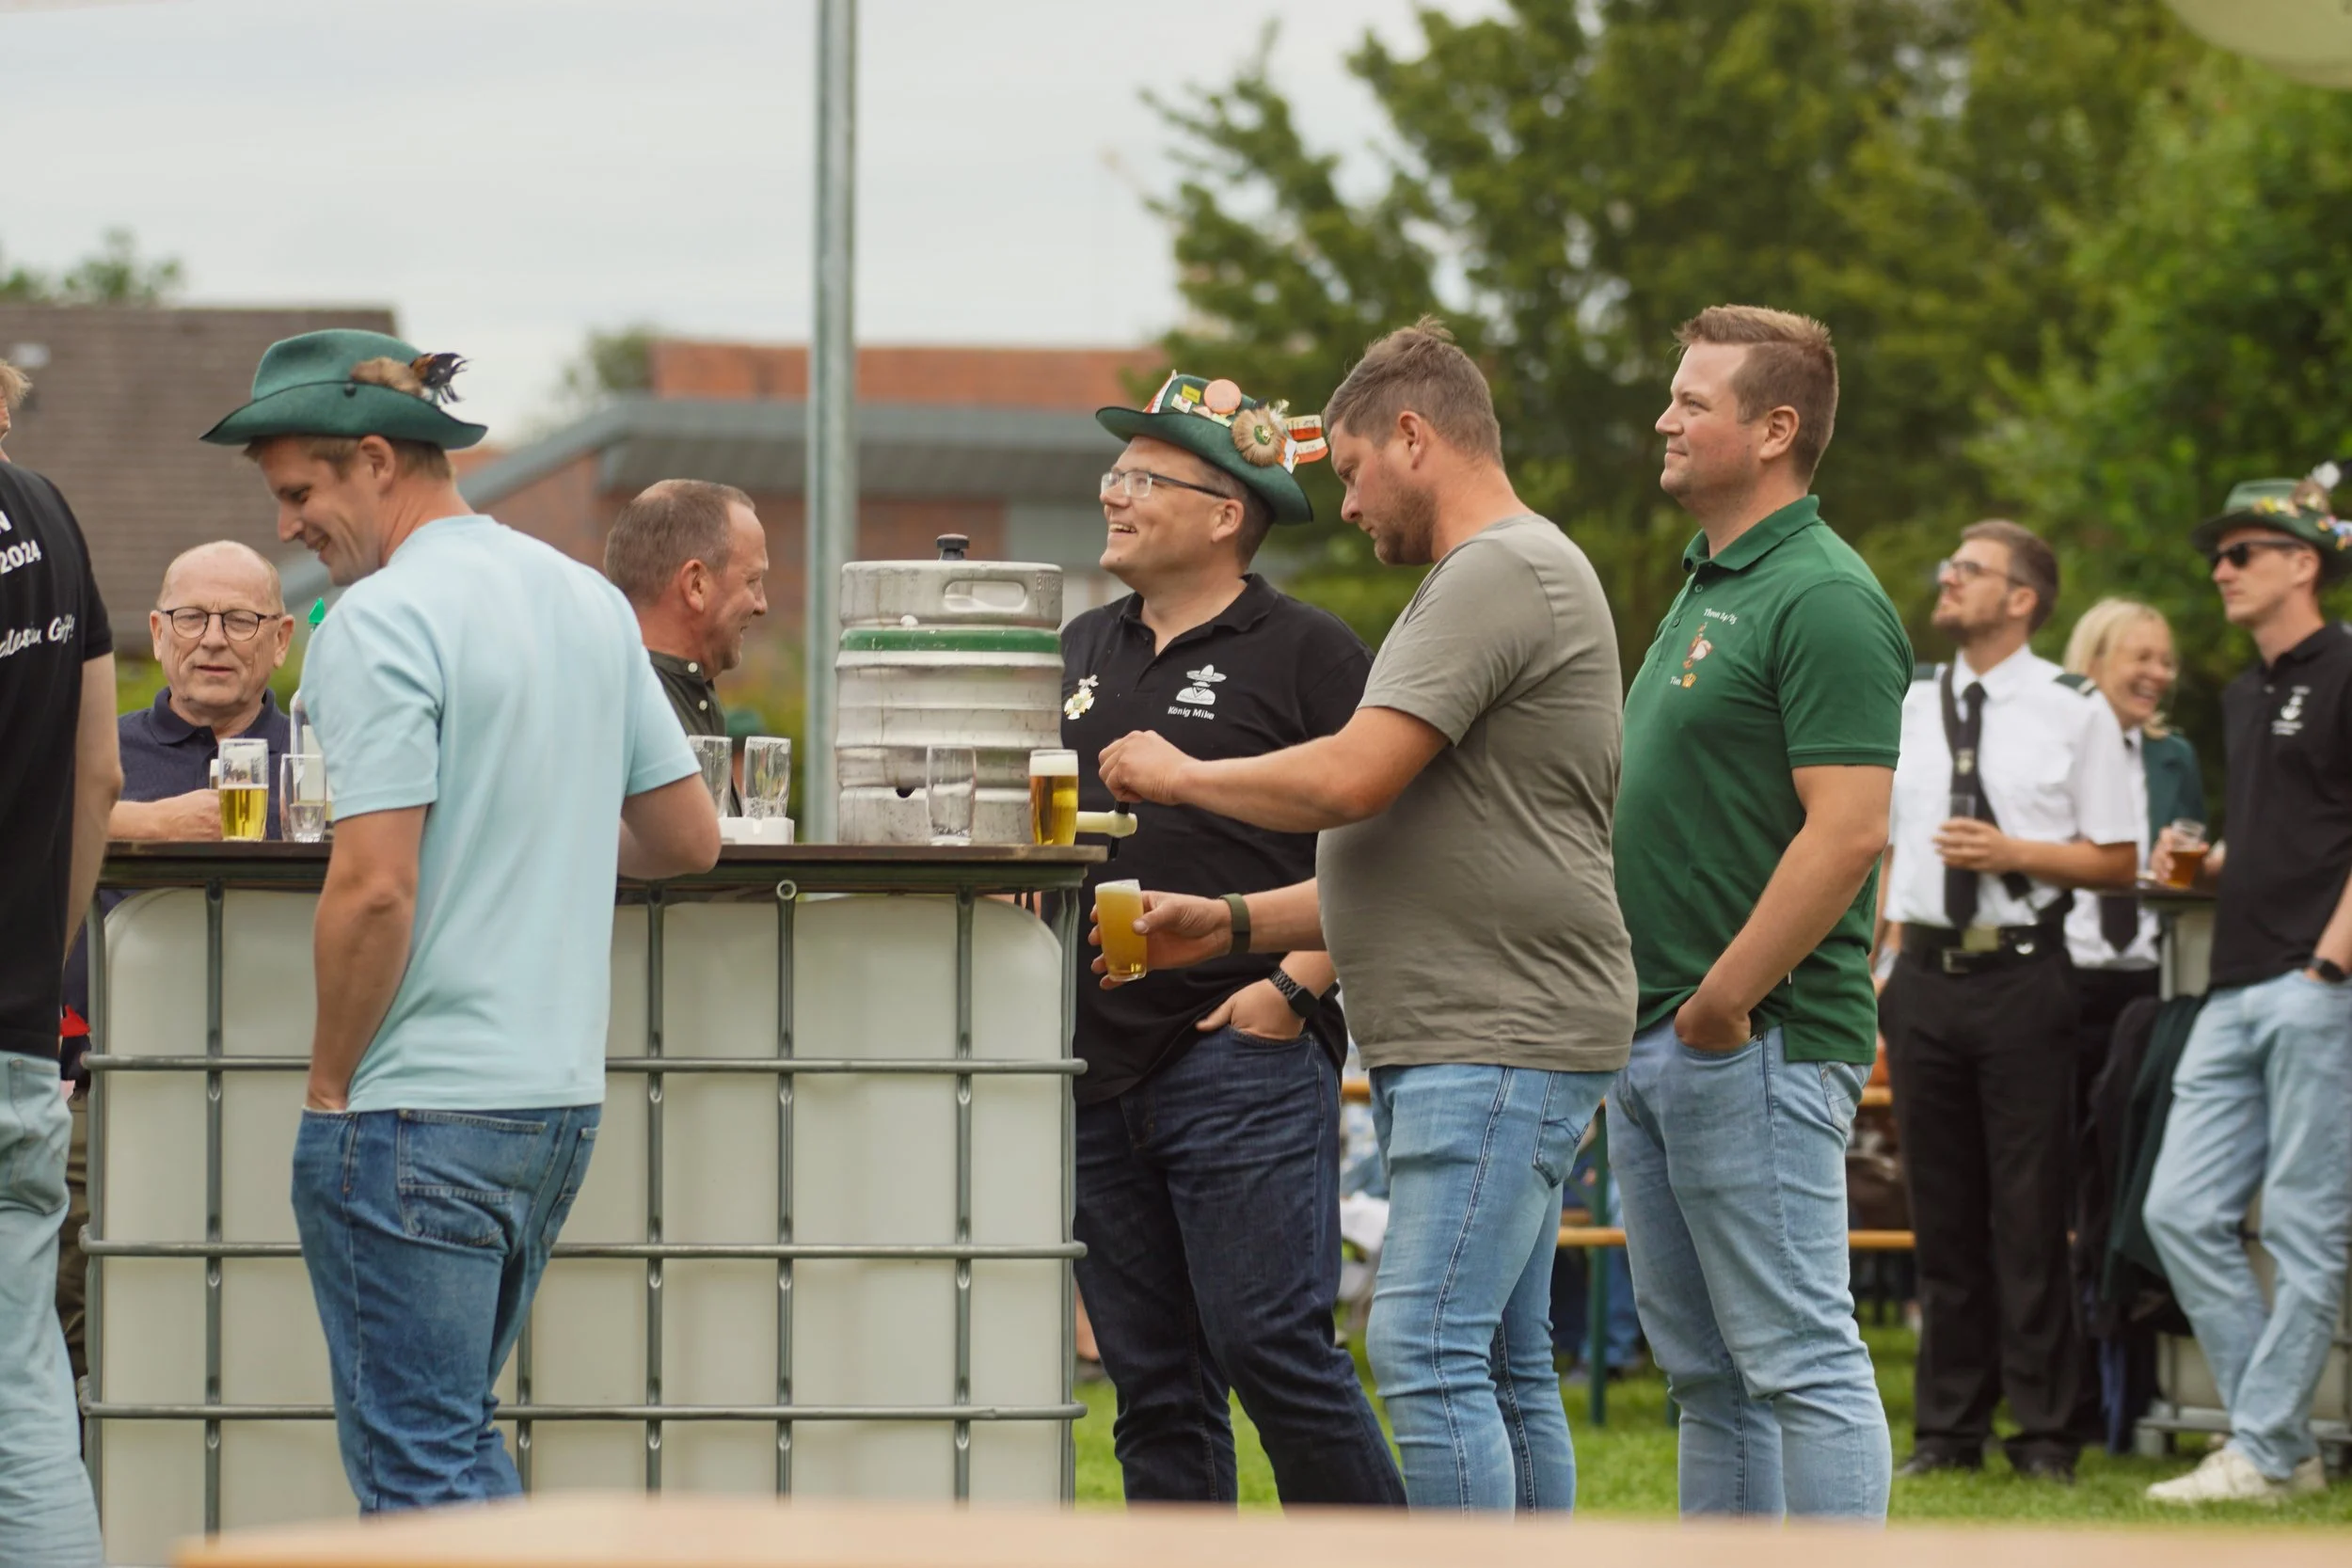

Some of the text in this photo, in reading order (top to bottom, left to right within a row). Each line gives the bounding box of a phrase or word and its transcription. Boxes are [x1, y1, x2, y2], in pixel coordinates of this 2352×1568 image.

[0, 539, 42, 575] 2024
[1168, 705, 1215, 720] König Mike
